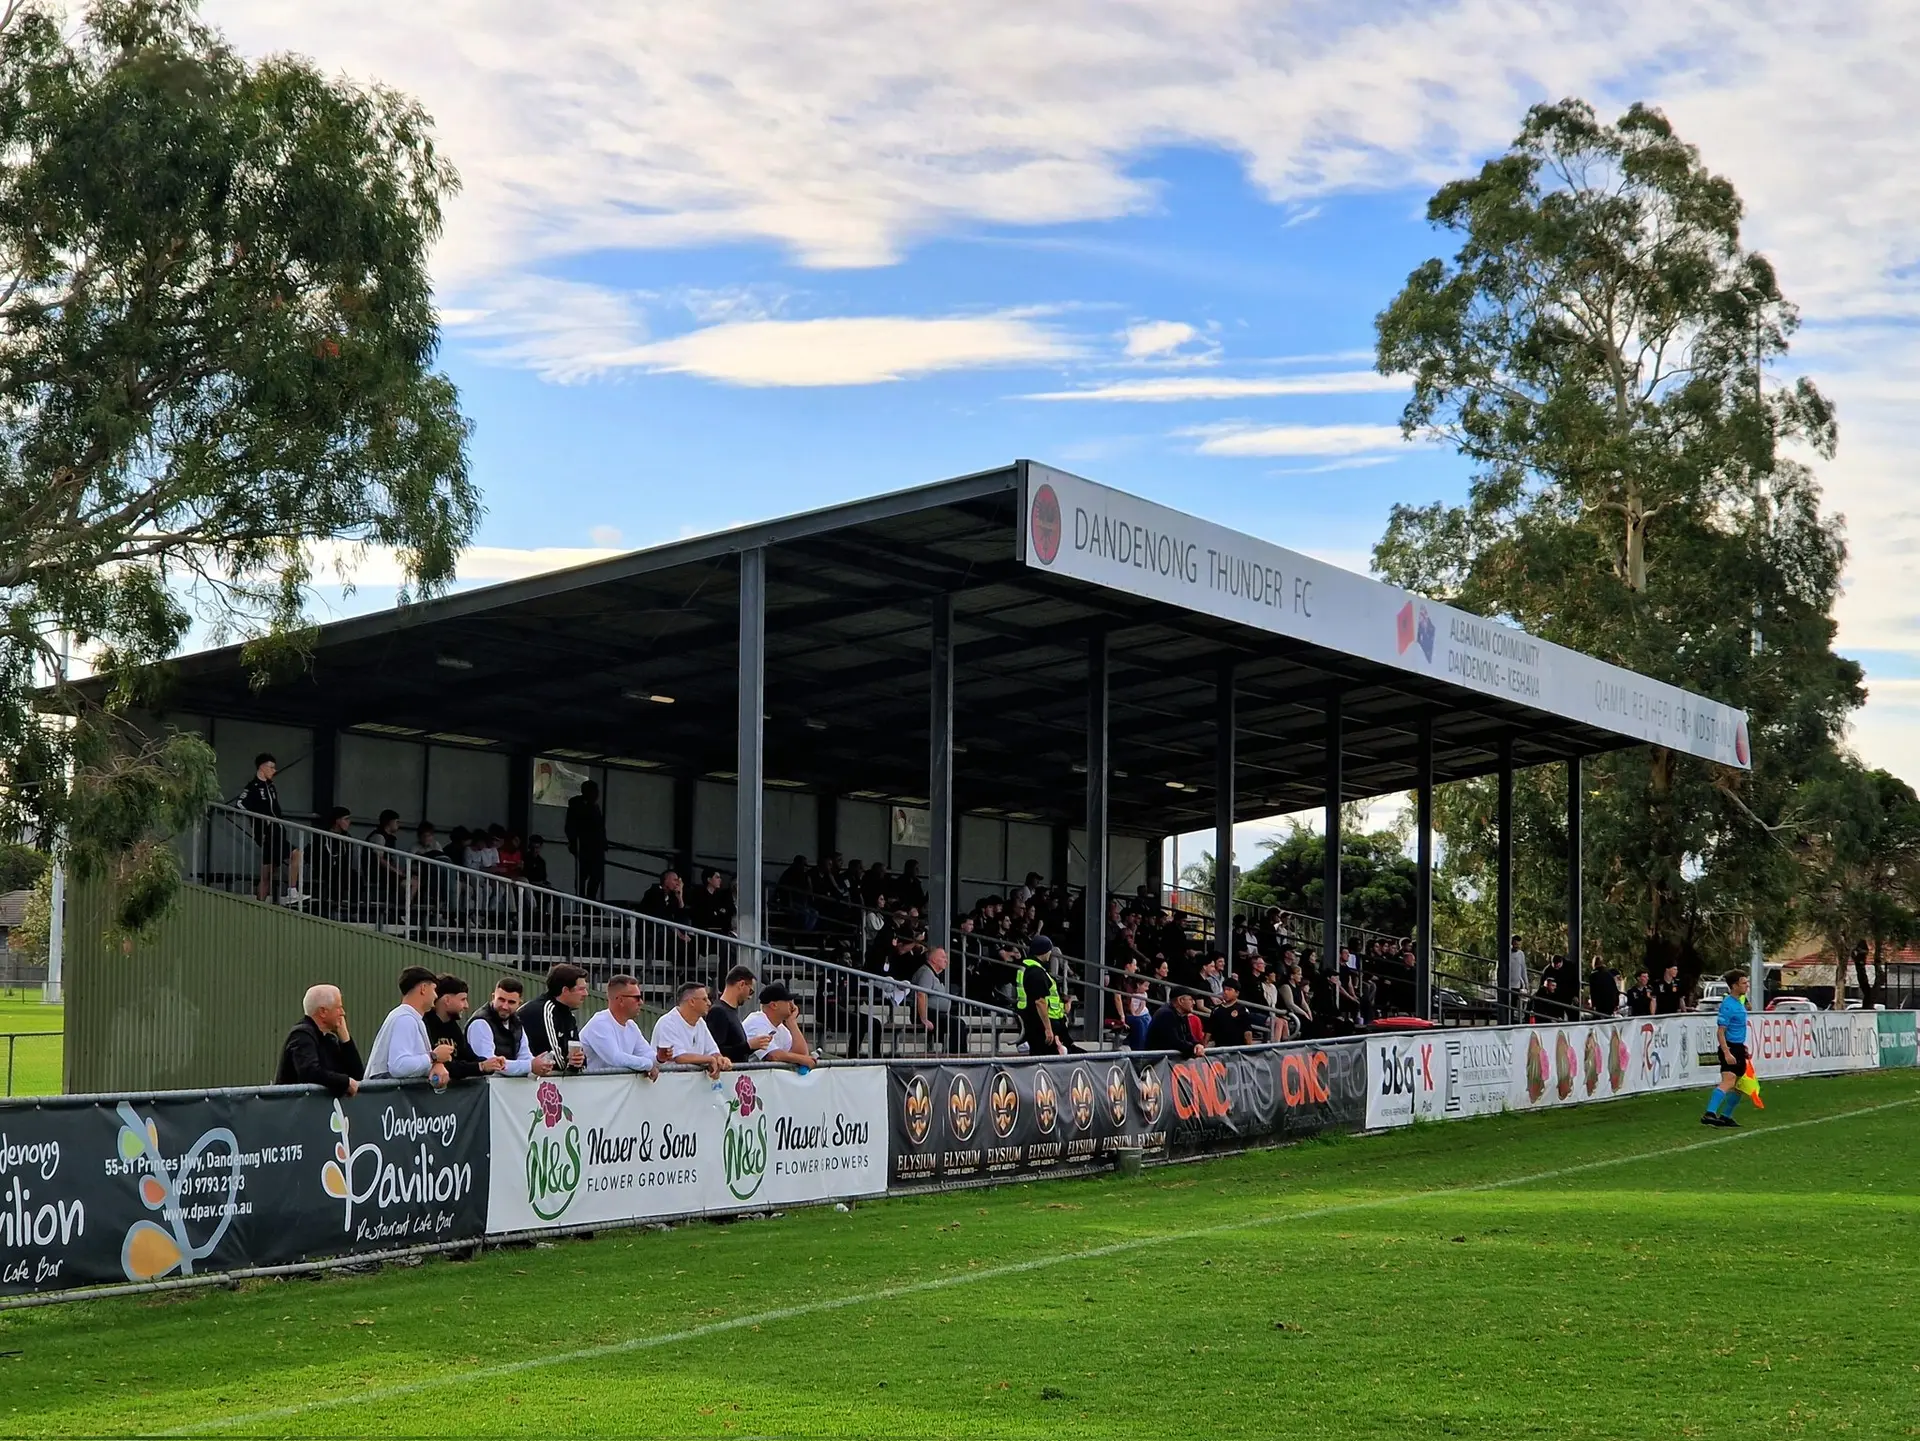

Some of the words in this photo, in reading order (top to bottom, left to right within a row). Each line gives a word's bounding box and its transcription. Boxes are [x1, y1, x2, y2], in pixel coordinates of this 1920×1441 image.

[1074, 507, 1197, 584] DANDENONG
[1207, 549, 1283, 609] THUNDER
[1294, 577, 1312, 618] FC
[1450, 617, 1491, 653] ALBANIAN
[1492, 632, 1540, 669] COMMUNITY
[1448, 648, 1500, 687] DANDENONG
[1594, 679, 1628, 716] QAMIL
[1462, 1043, 1513, 1068] EXCLUSIVE
[381, 1105, 457, 1147] Dandenong
[775, 1116, 819, 1151] Naser
[832, 1113, 869, 1147] Sons
[586, 1127, 637, 1166] Naser
[639, 1120, 653, 1162] &
[659, 1122, 698, 1160] Sons
[986, 1145, 1022, 1164] ELYSIUM
[1028, 1142, 1062, 1160] ELYSIUM
[1067, 1138, 1097, 1155] ELYSIUM
[1102, 1134, 1132, 1151] ELYSIUM
[104, 1156, 135, 1176] 55-61
[138, 1155, 178, 1174] Princes
[180, 1153, 205, 1173] Hwy,
[207, 1150, 260, 1171] Dandenong
[261, 1147, 279, 1164] VIC
[279, 1144, 303, 1162] 3175
[775, 1159, 818, 1175] FLOWER
[897, 1153, 937, 1171] ELYSIUM
[943, 1149, 981, 1168] ELYSIUM
[172, 1178, 192, 1197] (03)
[194, 1176, 219, 1194] 9793
[220, 1174, 245, 1192] 2133
[339, 1135, 472, 1232] Pavilion
[586, 1175, 633, 1192] FLOWER
[638, 1169, 698, 1188] GROWERS
[162, 1200, 252, 1223] www.dpav.com.au
[356, 1214, 411, 1242] Restaurant
[413, 1211, 432, 1233] Cafe
[435, 1210, 455, 1233] Bar
[3, 1259, 30, 1283] Cafe
[35, 1256, 64, 1283] Bar
